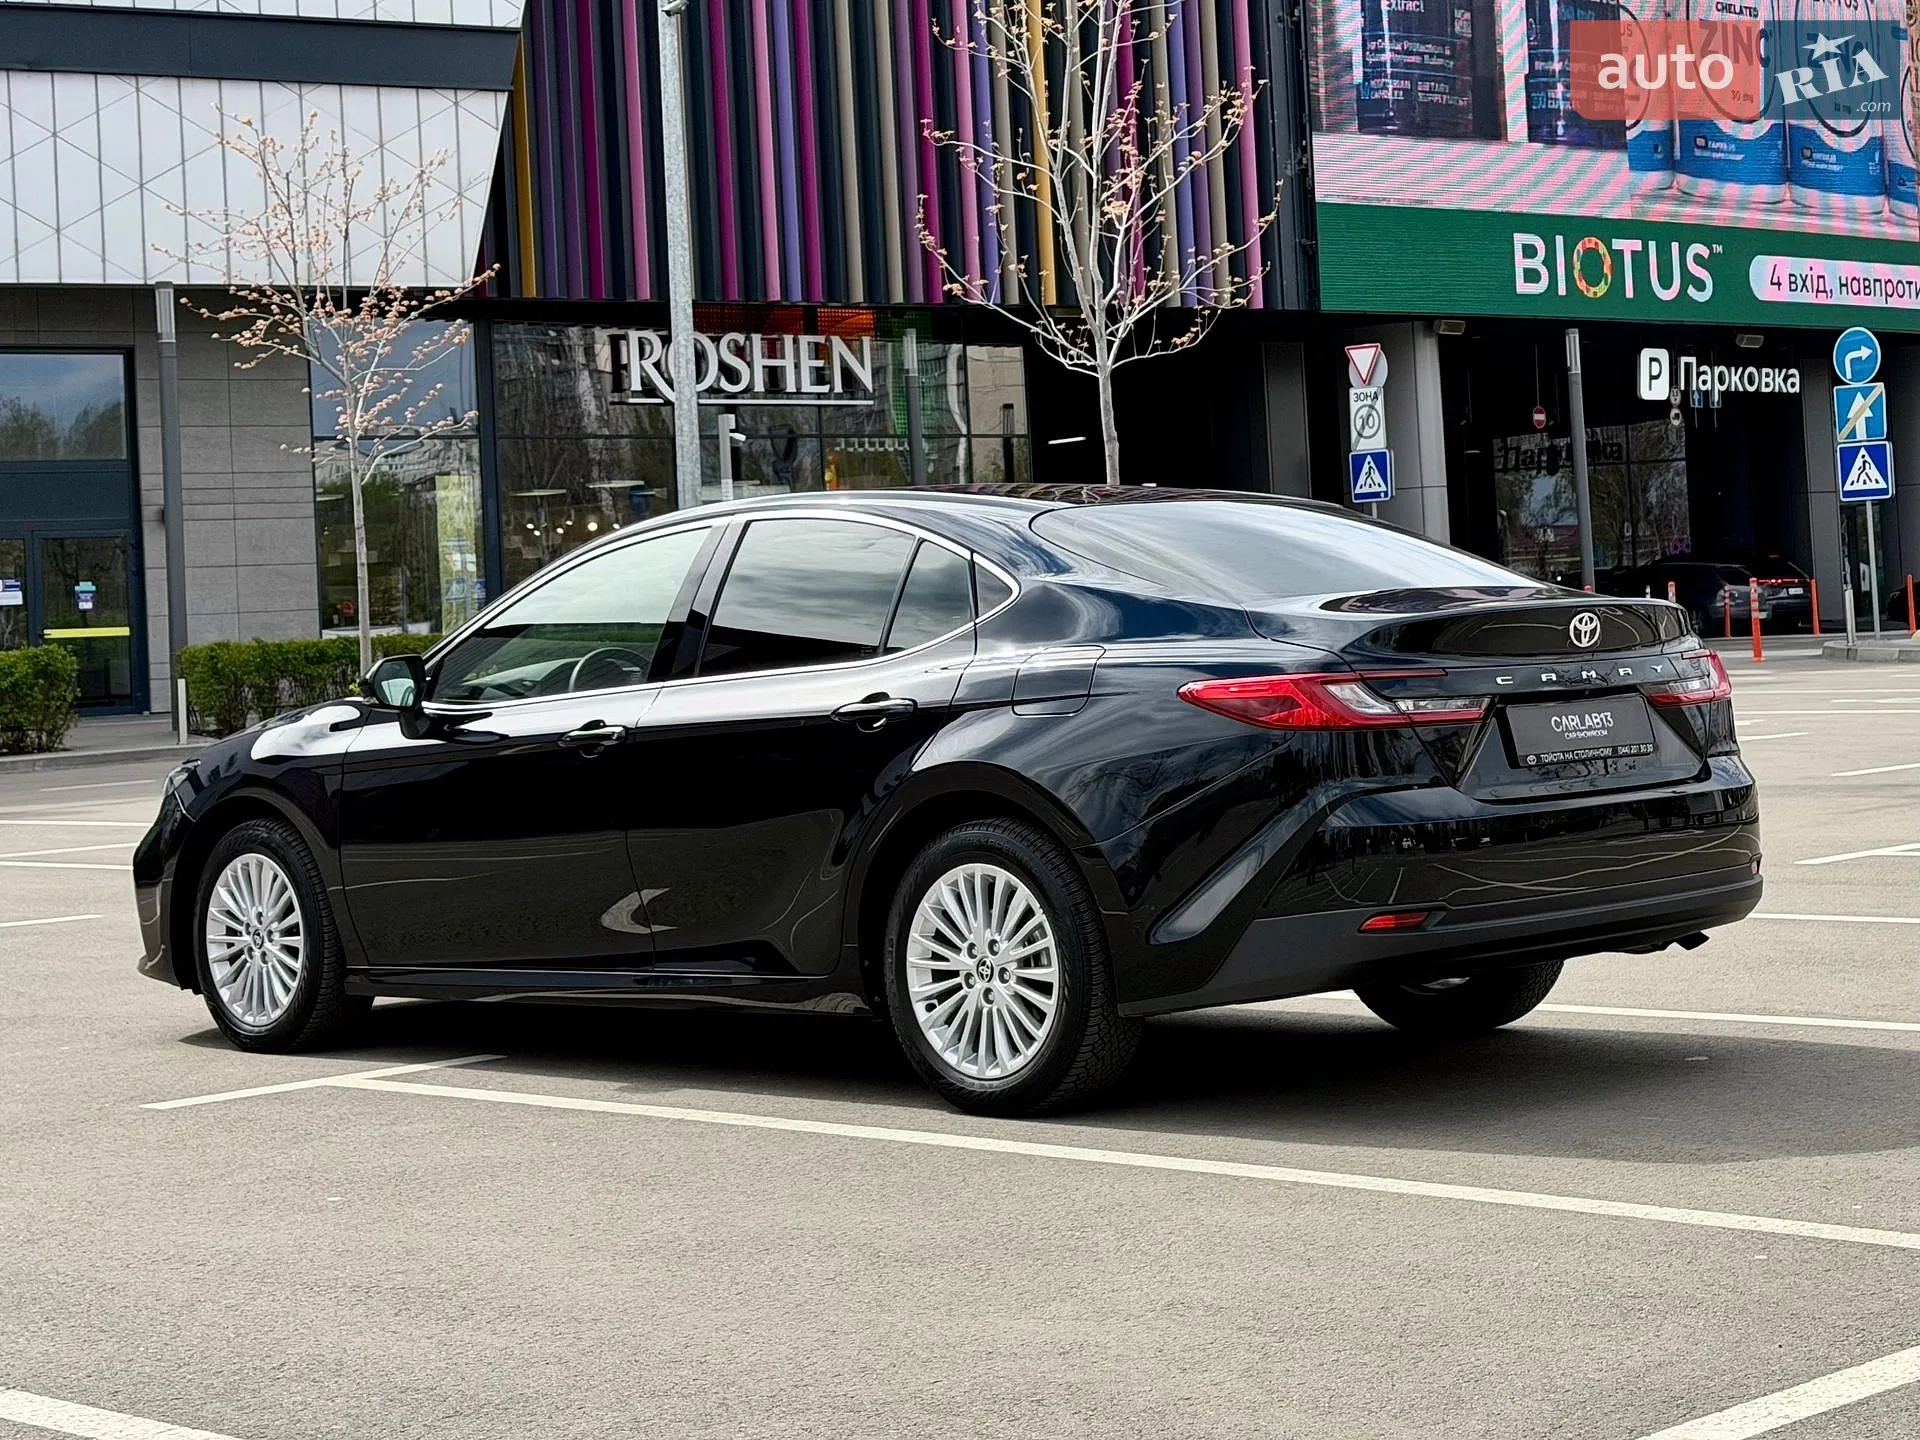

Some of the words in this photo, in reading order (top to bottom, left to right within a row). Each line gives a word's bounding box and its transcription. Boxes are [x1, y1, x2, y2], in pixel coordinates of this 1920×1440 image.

[1715, 1, 1759, 18] CHELATED
[1513, 233, 1714, 302] BIOTUS
[1769, 263, 1782, 291] 4
[1788, 273, 1834, 298] вхід,
[627, 329, 874, 403] ROSHEN
[1680, 356, 1800, 403] Парковка
[1353, 390, 1379, 403] ЗОНА
[1359, 413, 1375, 430] 10
[1495, 664, 1663, 686] CAMRY
[1551, 711, 1614, 732] CARLAB13
